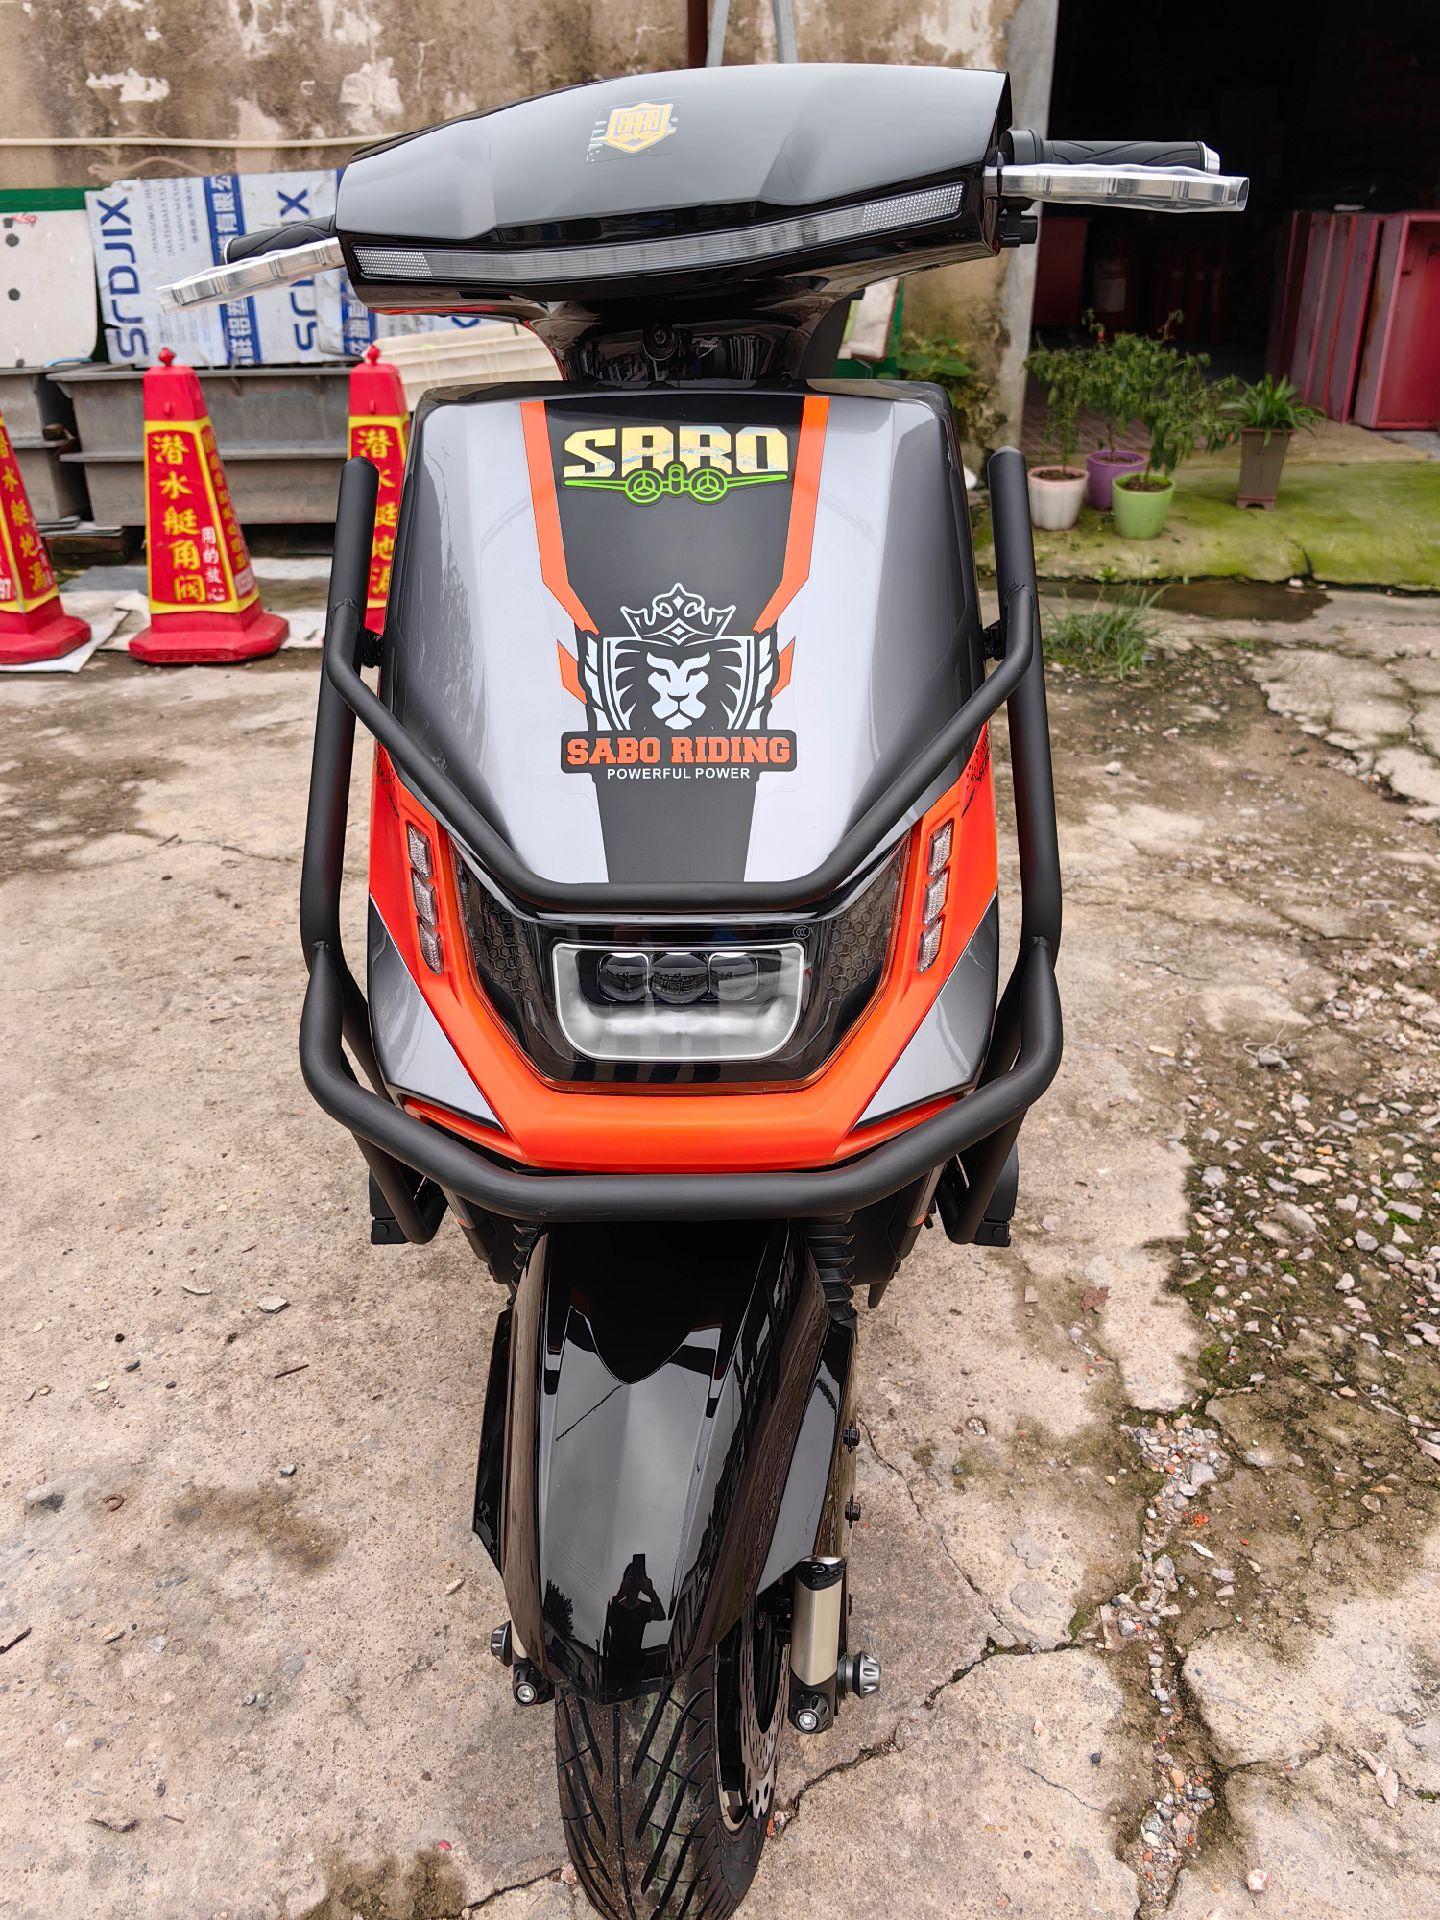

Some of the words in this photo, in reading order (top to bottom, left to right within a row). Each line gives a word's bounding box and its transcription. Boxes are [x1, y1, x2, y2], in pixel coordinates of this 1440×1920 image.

[566, 736, 661, 765] SABO
[670, 736, 790, 764] RIDING
[607, 768, 690, 780] POWERFUL
[695, 767, 750, 780] POWER
